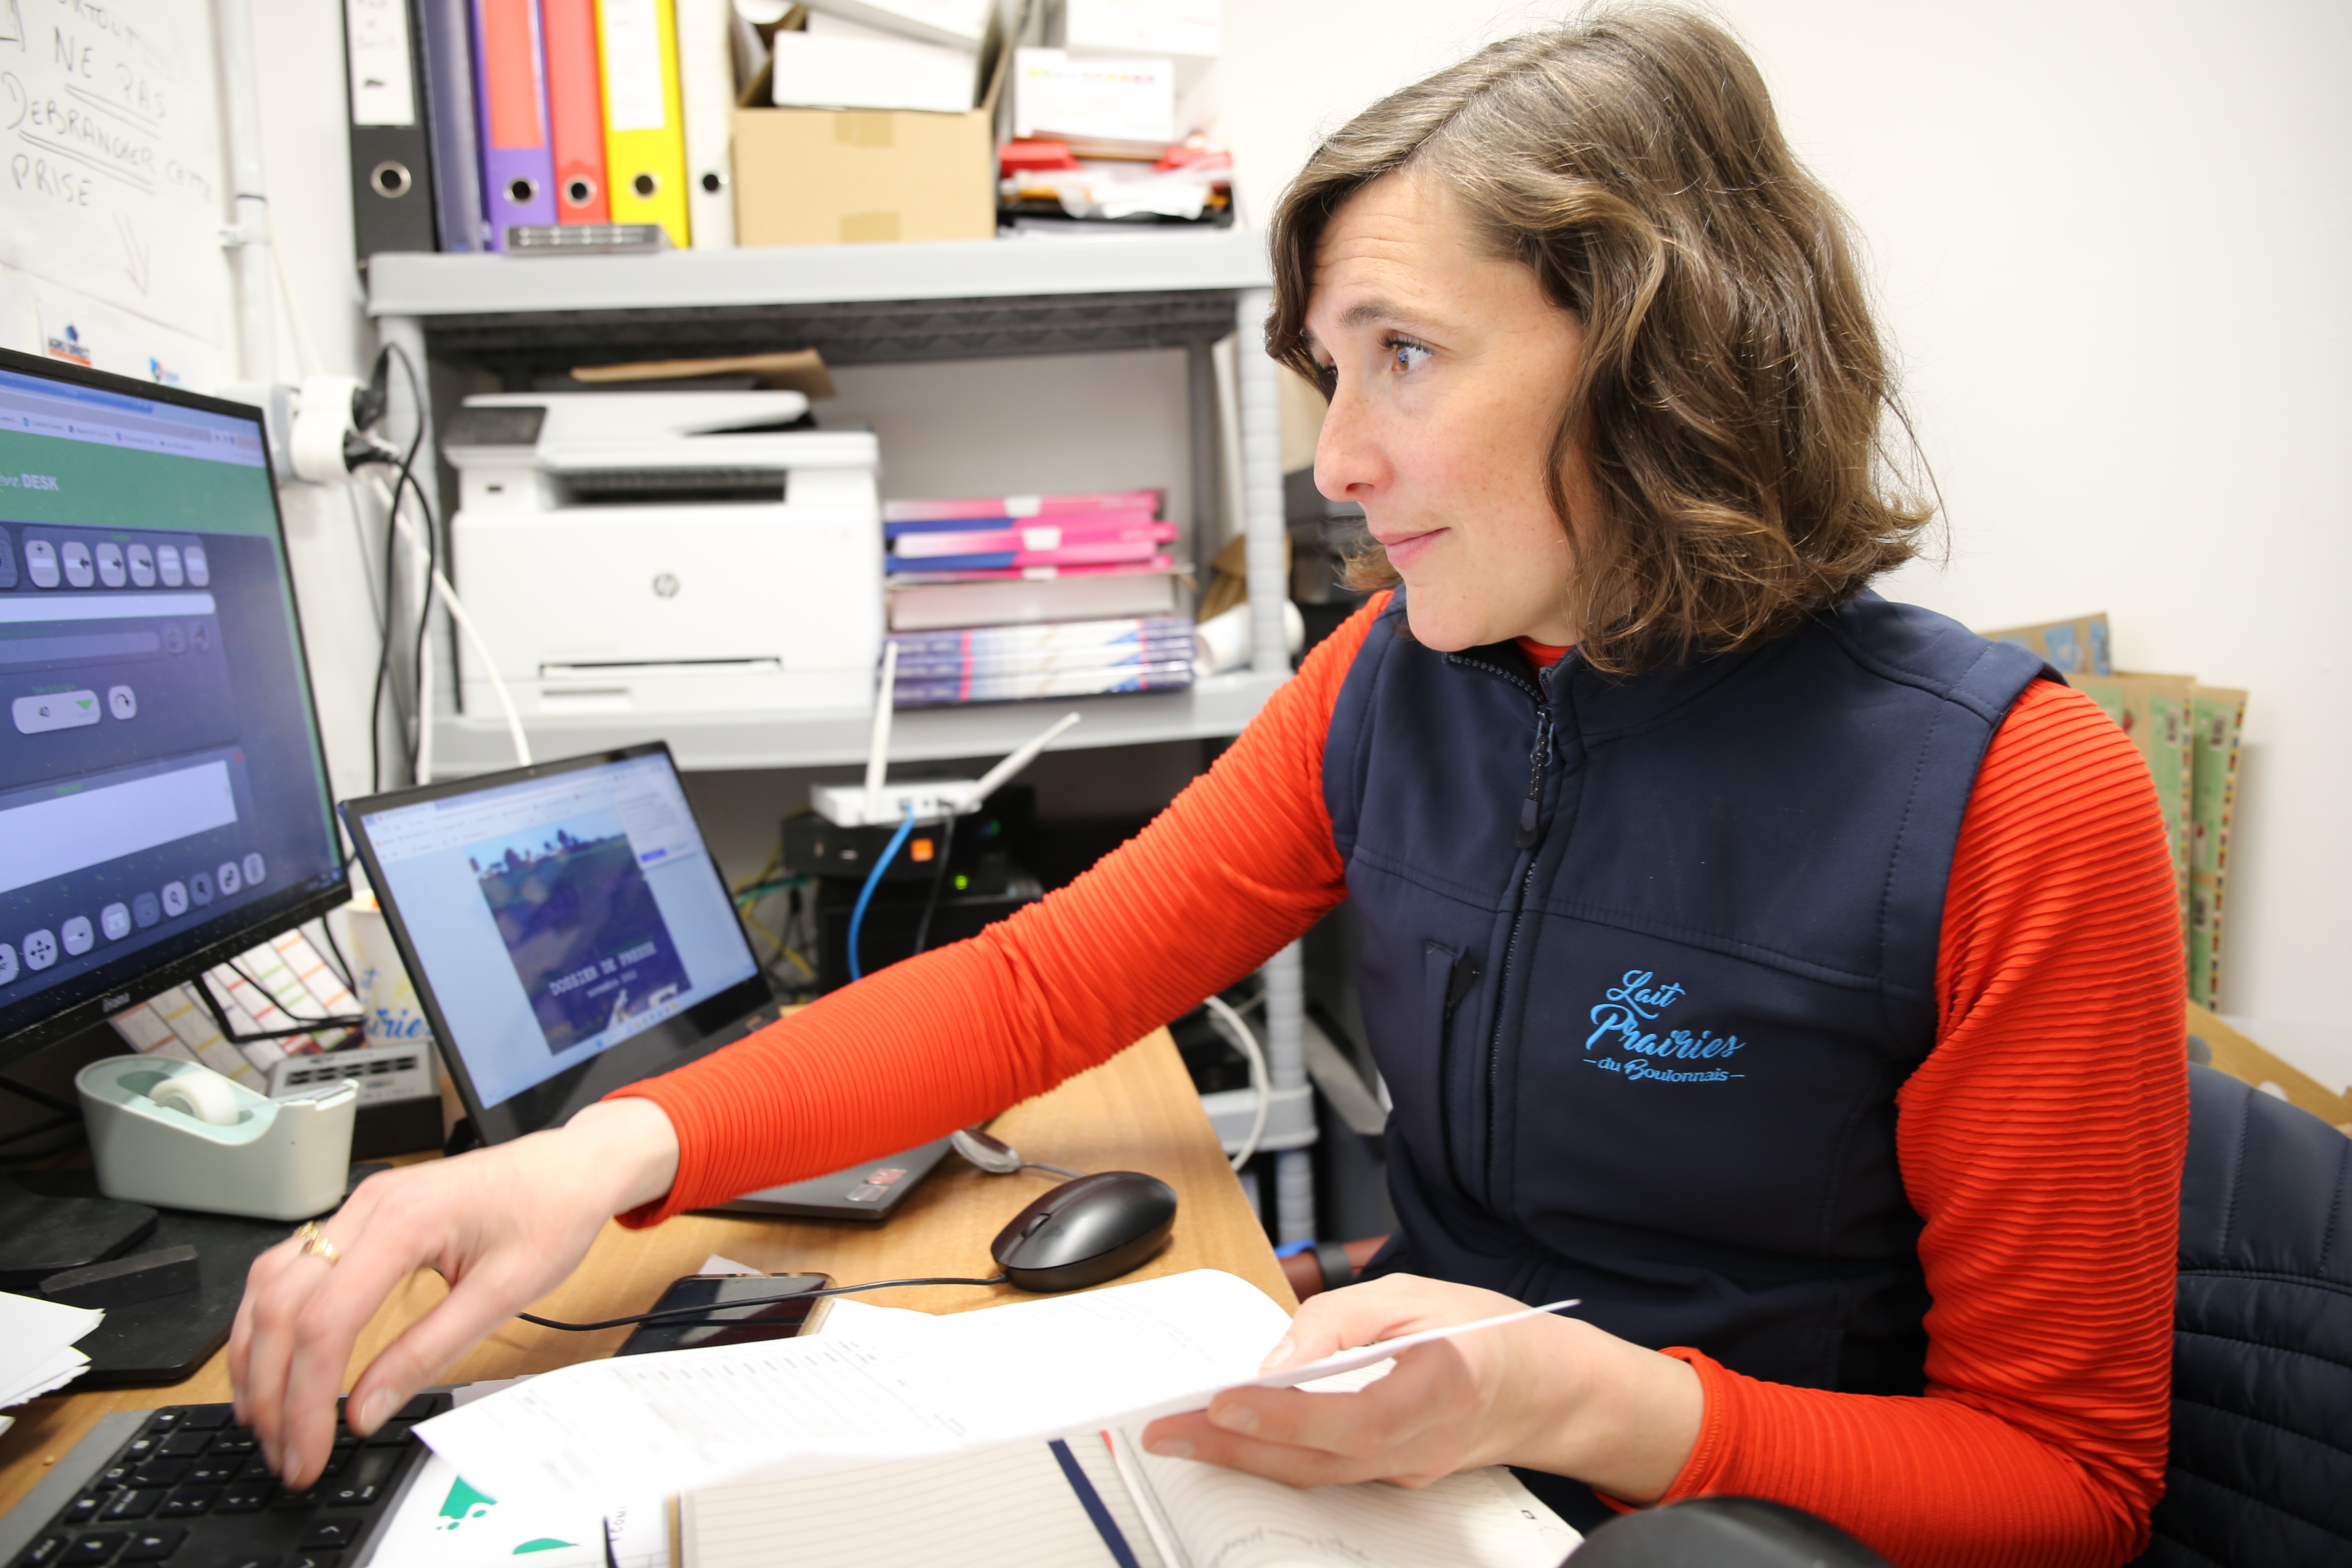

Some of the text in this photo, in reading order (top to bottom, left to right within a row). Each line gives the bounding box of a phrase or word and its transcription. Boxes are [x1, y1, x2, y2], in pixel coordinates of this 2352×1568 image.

[54, 25, 167, 118] NE PAS
[11, 153, 94, 207] PRISE
[20, 472, 60, 492] DESK
[1606, 969, 1686, 1019] Lait
[1585, 1004, 1746, 1058] Prairies
[1597, 1057, 1730, 1082] du Boulonnais
